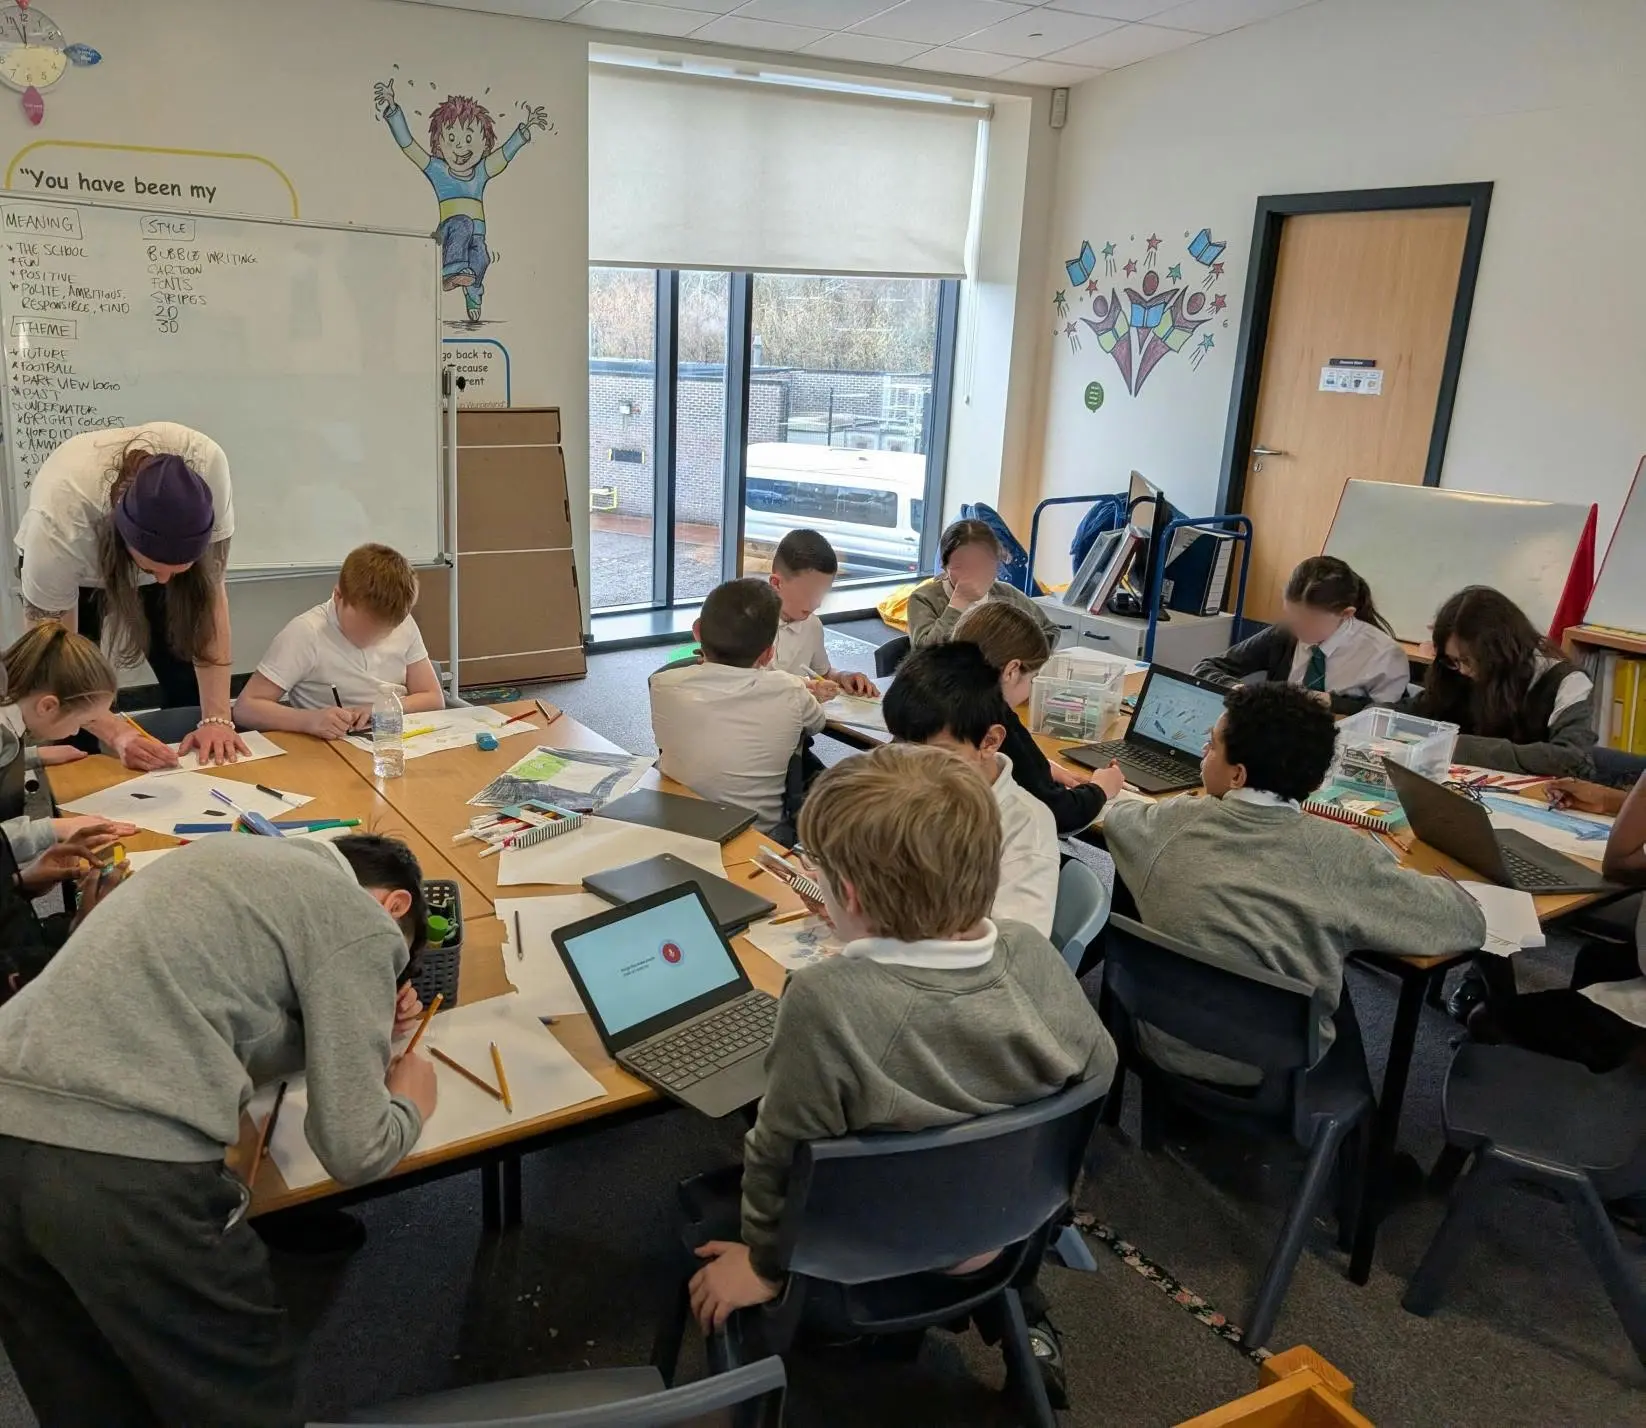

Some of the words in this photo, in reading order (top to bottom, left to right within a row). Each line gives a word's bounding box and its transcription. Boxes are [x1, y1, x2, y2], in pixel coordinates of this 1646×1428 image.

[20, 13, 28, 22] 12
[48, 31, 54, 40] 2
[51, 62, 57, 70] 4
[26, 73, 32, 82] 6
[41, 71, 47, 80] 5
[78, 172, 125, 193] have
[134, 177, 182, 197] been
[190, 184, 217, 203] my
[6, 213, 74, 232] MEANING
[148, 219, 187, 234] STYLE
[16, 242, 38, 256] THE
[43, 244, 88, 257] SCHOOL
[147, 245, 200, 261] BUBBLE
[207, 251, 259, 265] WRITING
[18, 256, 40, 267] FUN
[20, 268, 78, 284] POSITIVE
[147, 264, 203, 276] CARTOON
[151, 276, 193, 291] FONTS
[150, 291, 207, 305] STRIPES
[98, 302, 130, 314] KIND
[155, 305, 178, 320] 2D
[16, 322, 70, 337] THEME
[156, 319, 179, 333] 3D
[442, 352, 452, 361] go
[456, 348, 479, 359] back
[482, 350, 493, 359] to
[21, 361, 77, 375] FOOTBALL
[22, 374, 53, 387] PARK
[57, 378, 90, 391] VIEW
[92, 379, 121, 391] LOGO
[22, 387, 60, 400] PAST
[24, 400, 97, 415] UNDERWATER
[23, 412, 75, 426] BRIGHT
